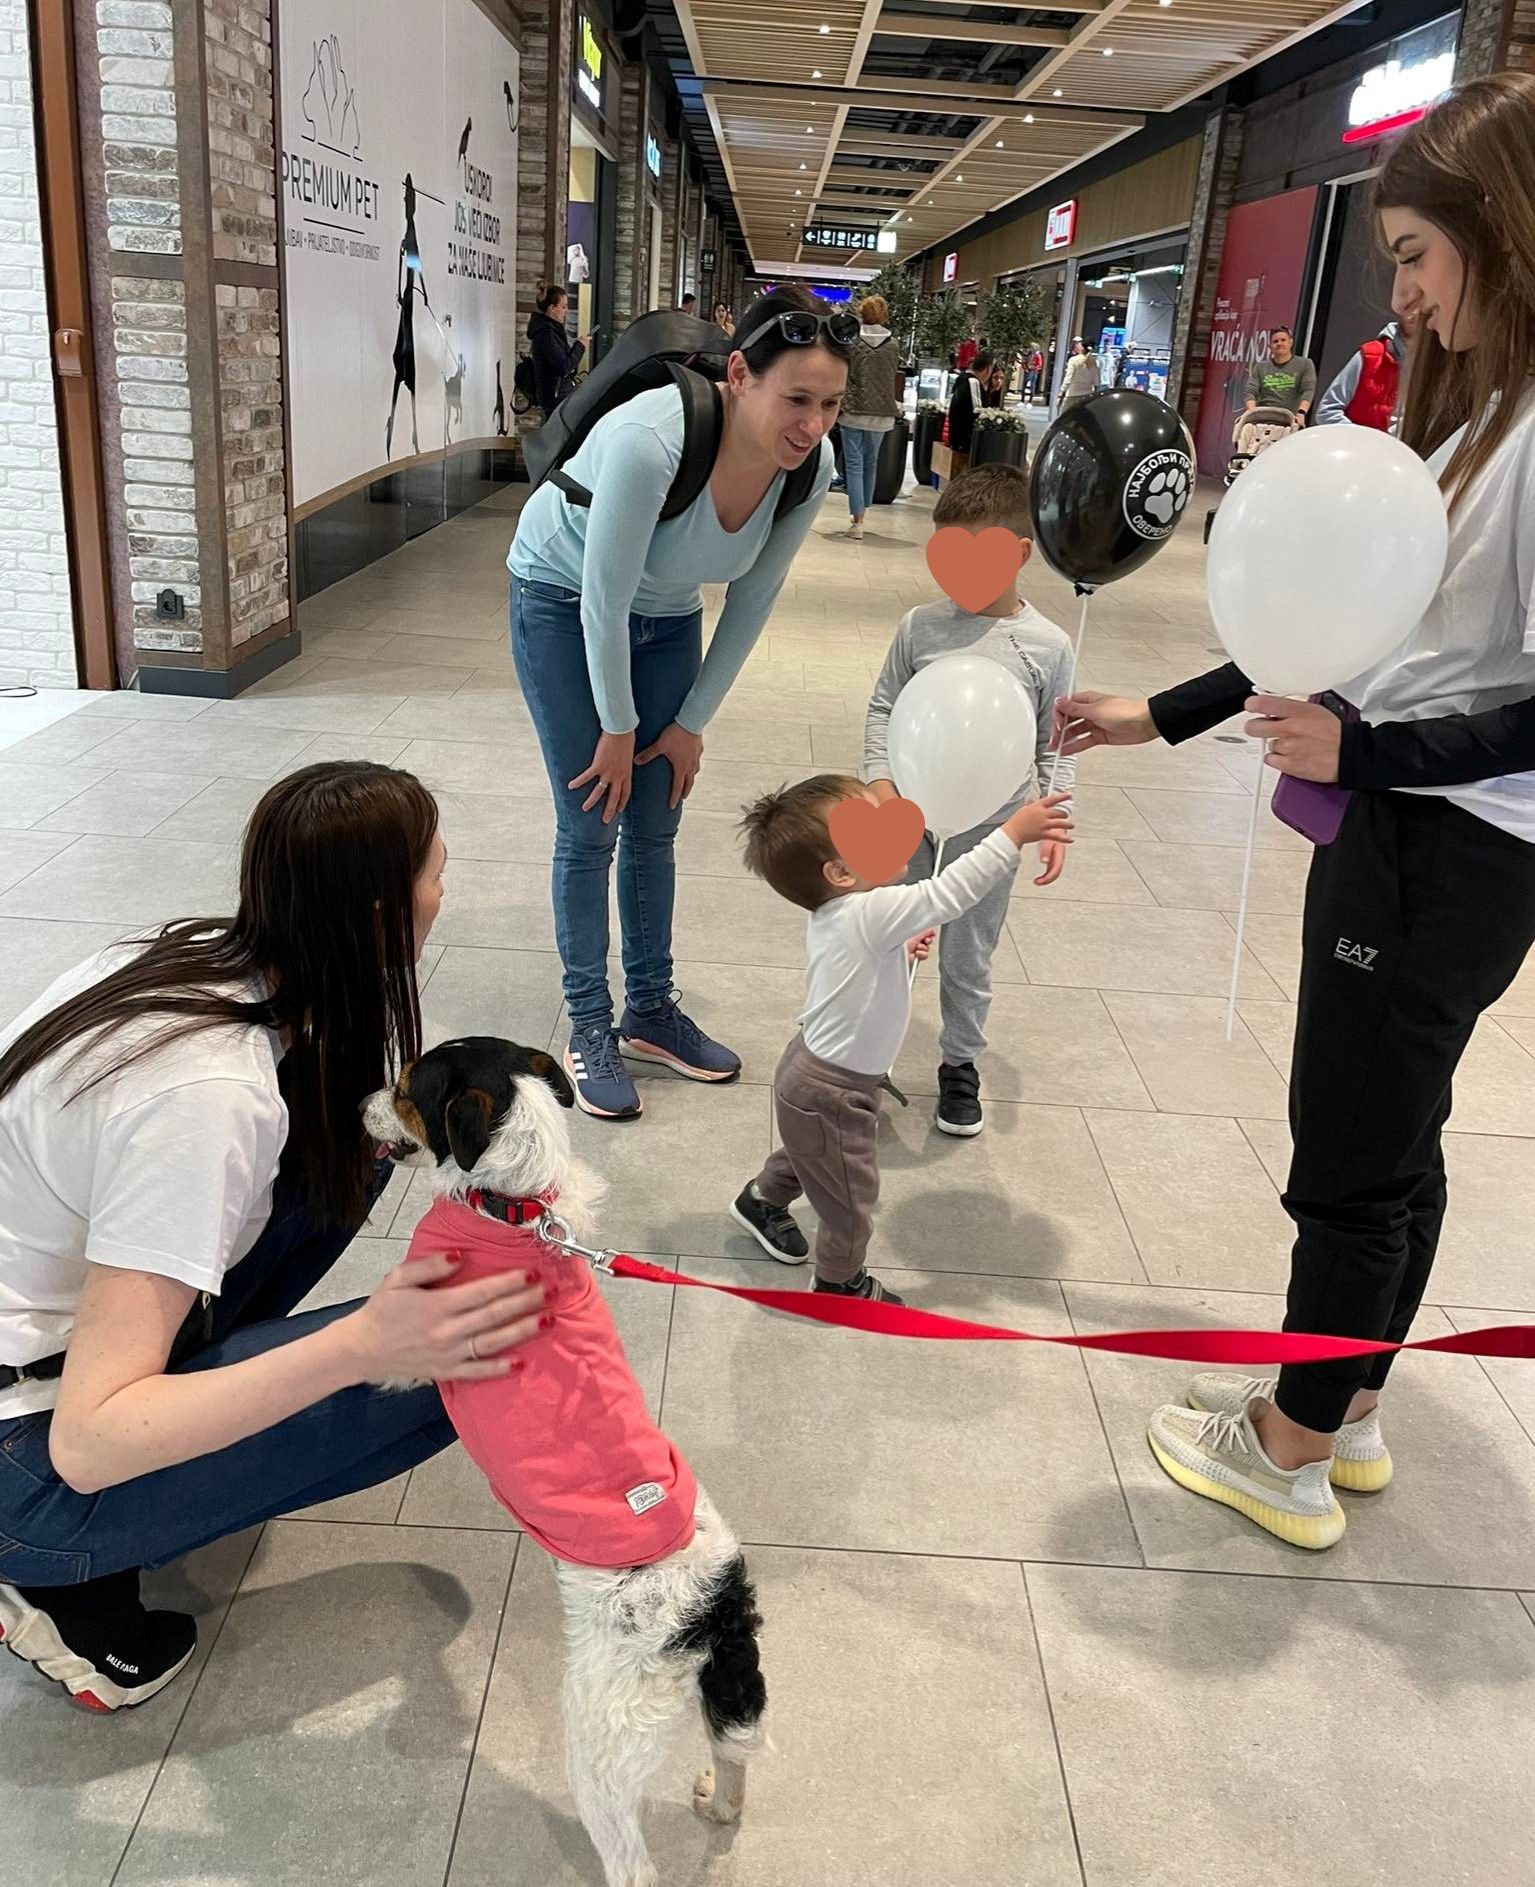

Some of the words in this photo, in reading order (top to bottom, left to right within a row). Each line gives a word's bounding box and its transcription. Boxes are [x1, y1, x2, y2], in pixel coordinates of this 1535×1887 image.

[282, 150, 351, 214] PREMIUM
[355, 176, 379, 221] PET
[1210, 323, 1245, 362] VRAĆA
[1128, 453, 1178, 498] НАЈБОЉИ
[1335, 937, 1379, 965] EA7
